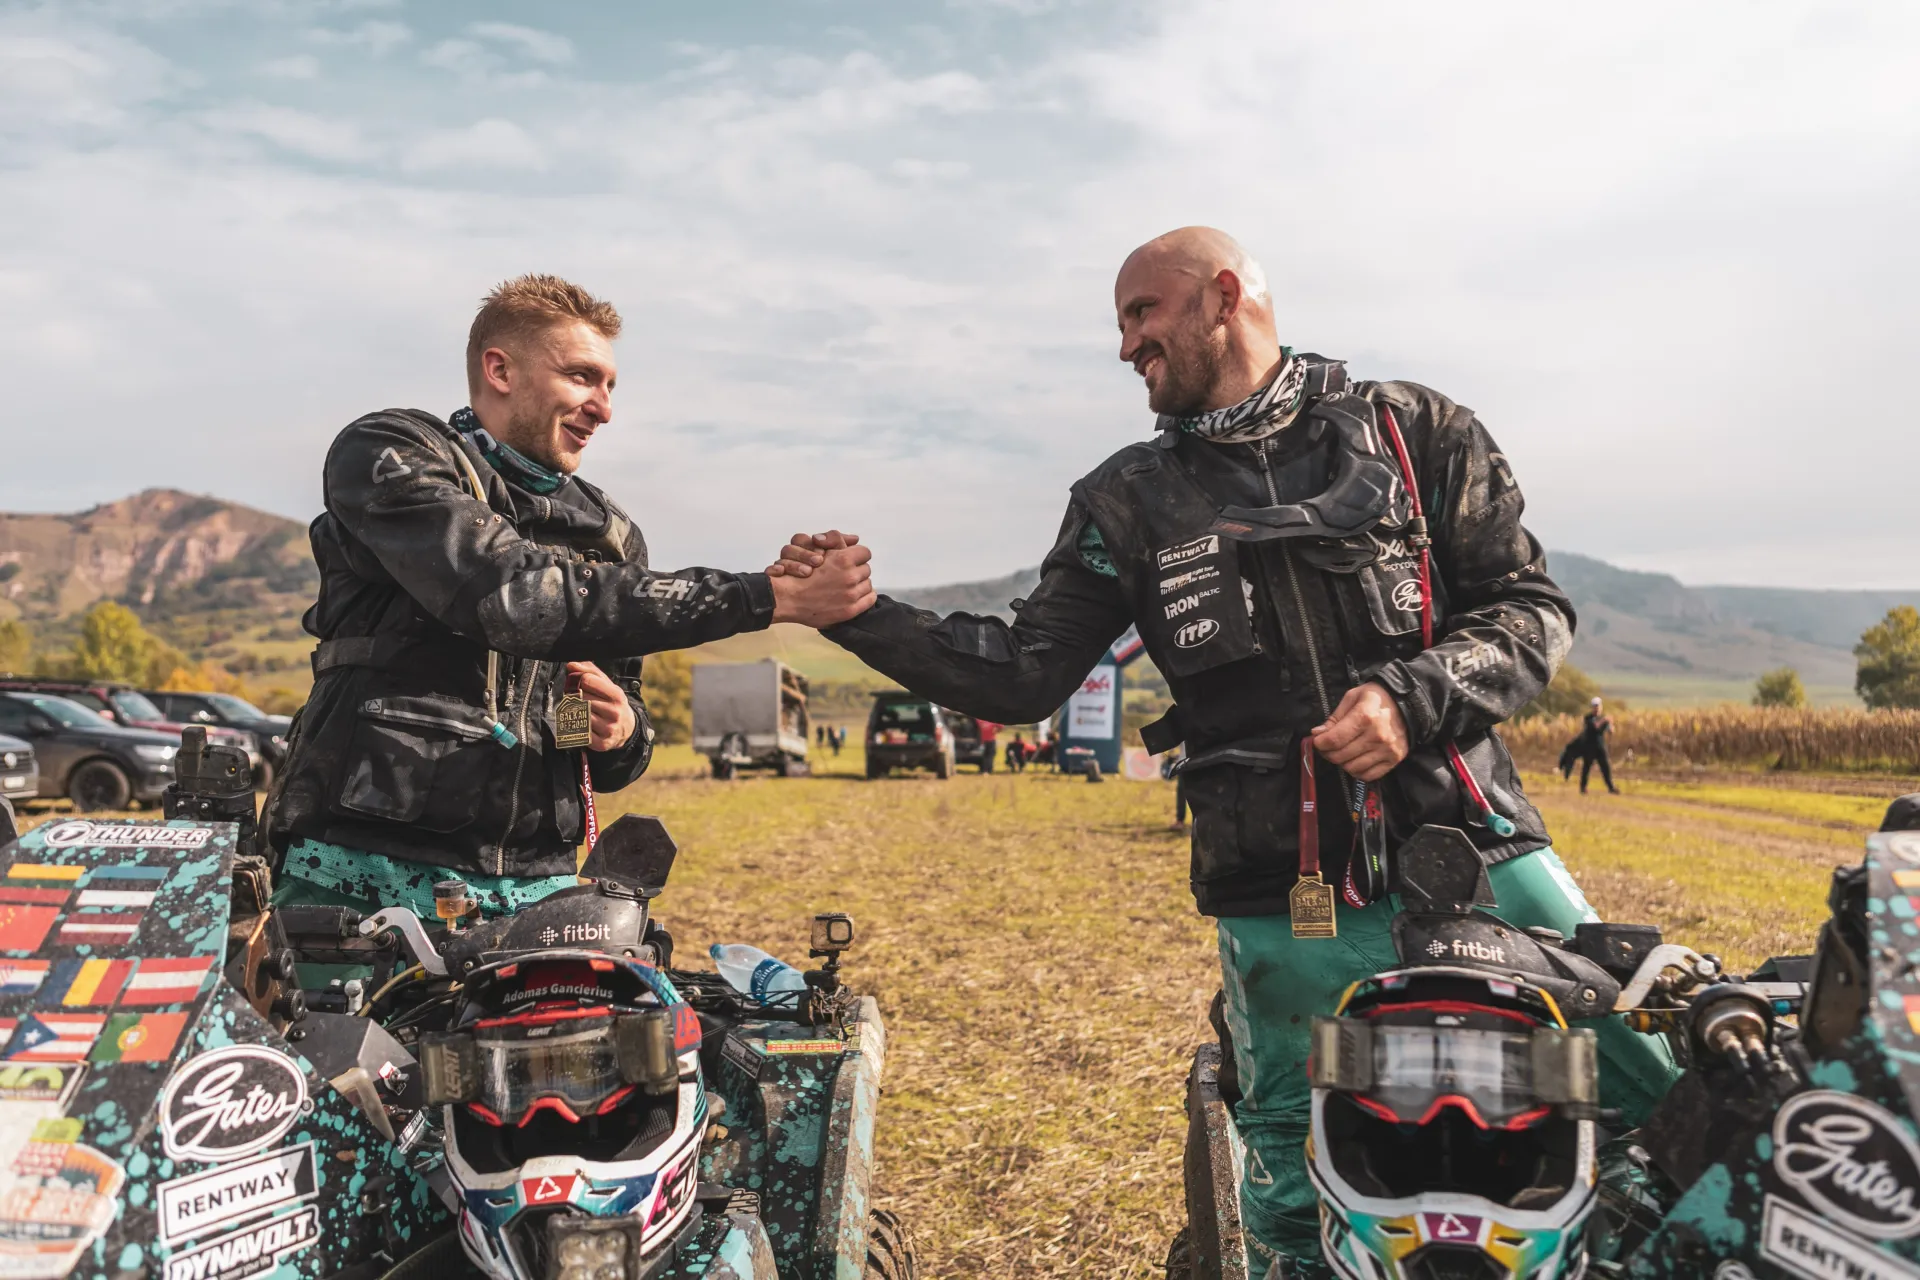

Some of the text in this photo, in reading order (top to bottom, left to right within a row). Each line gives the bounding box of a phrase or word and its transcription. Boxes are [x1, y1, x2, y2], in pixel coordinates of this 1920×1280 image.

[1161, 542, 1207, 564] RENTWAY
[1164, 587, 1220, 620] IRON BALTIC
[1179, 620, 1212, 646] ITP
[559, 720, 588, 731] OFFROAD
[560, 710, 588, 722] BALKAN
[92, 826, 208, 841] THUNDER
[563, 923, 611, 942] fitbit
[1452, 939, 1506, 963] fitbit
[502, 983, 614, 1004] Adomas Gancierius
[170, 1062, 298, 1150] Gates
[1778, 1114, 1920, 1218] Gates
[177, 1168, 290, 1221] RENTWAY
[168, 1211, 314, 1280] DYNAVOLT
